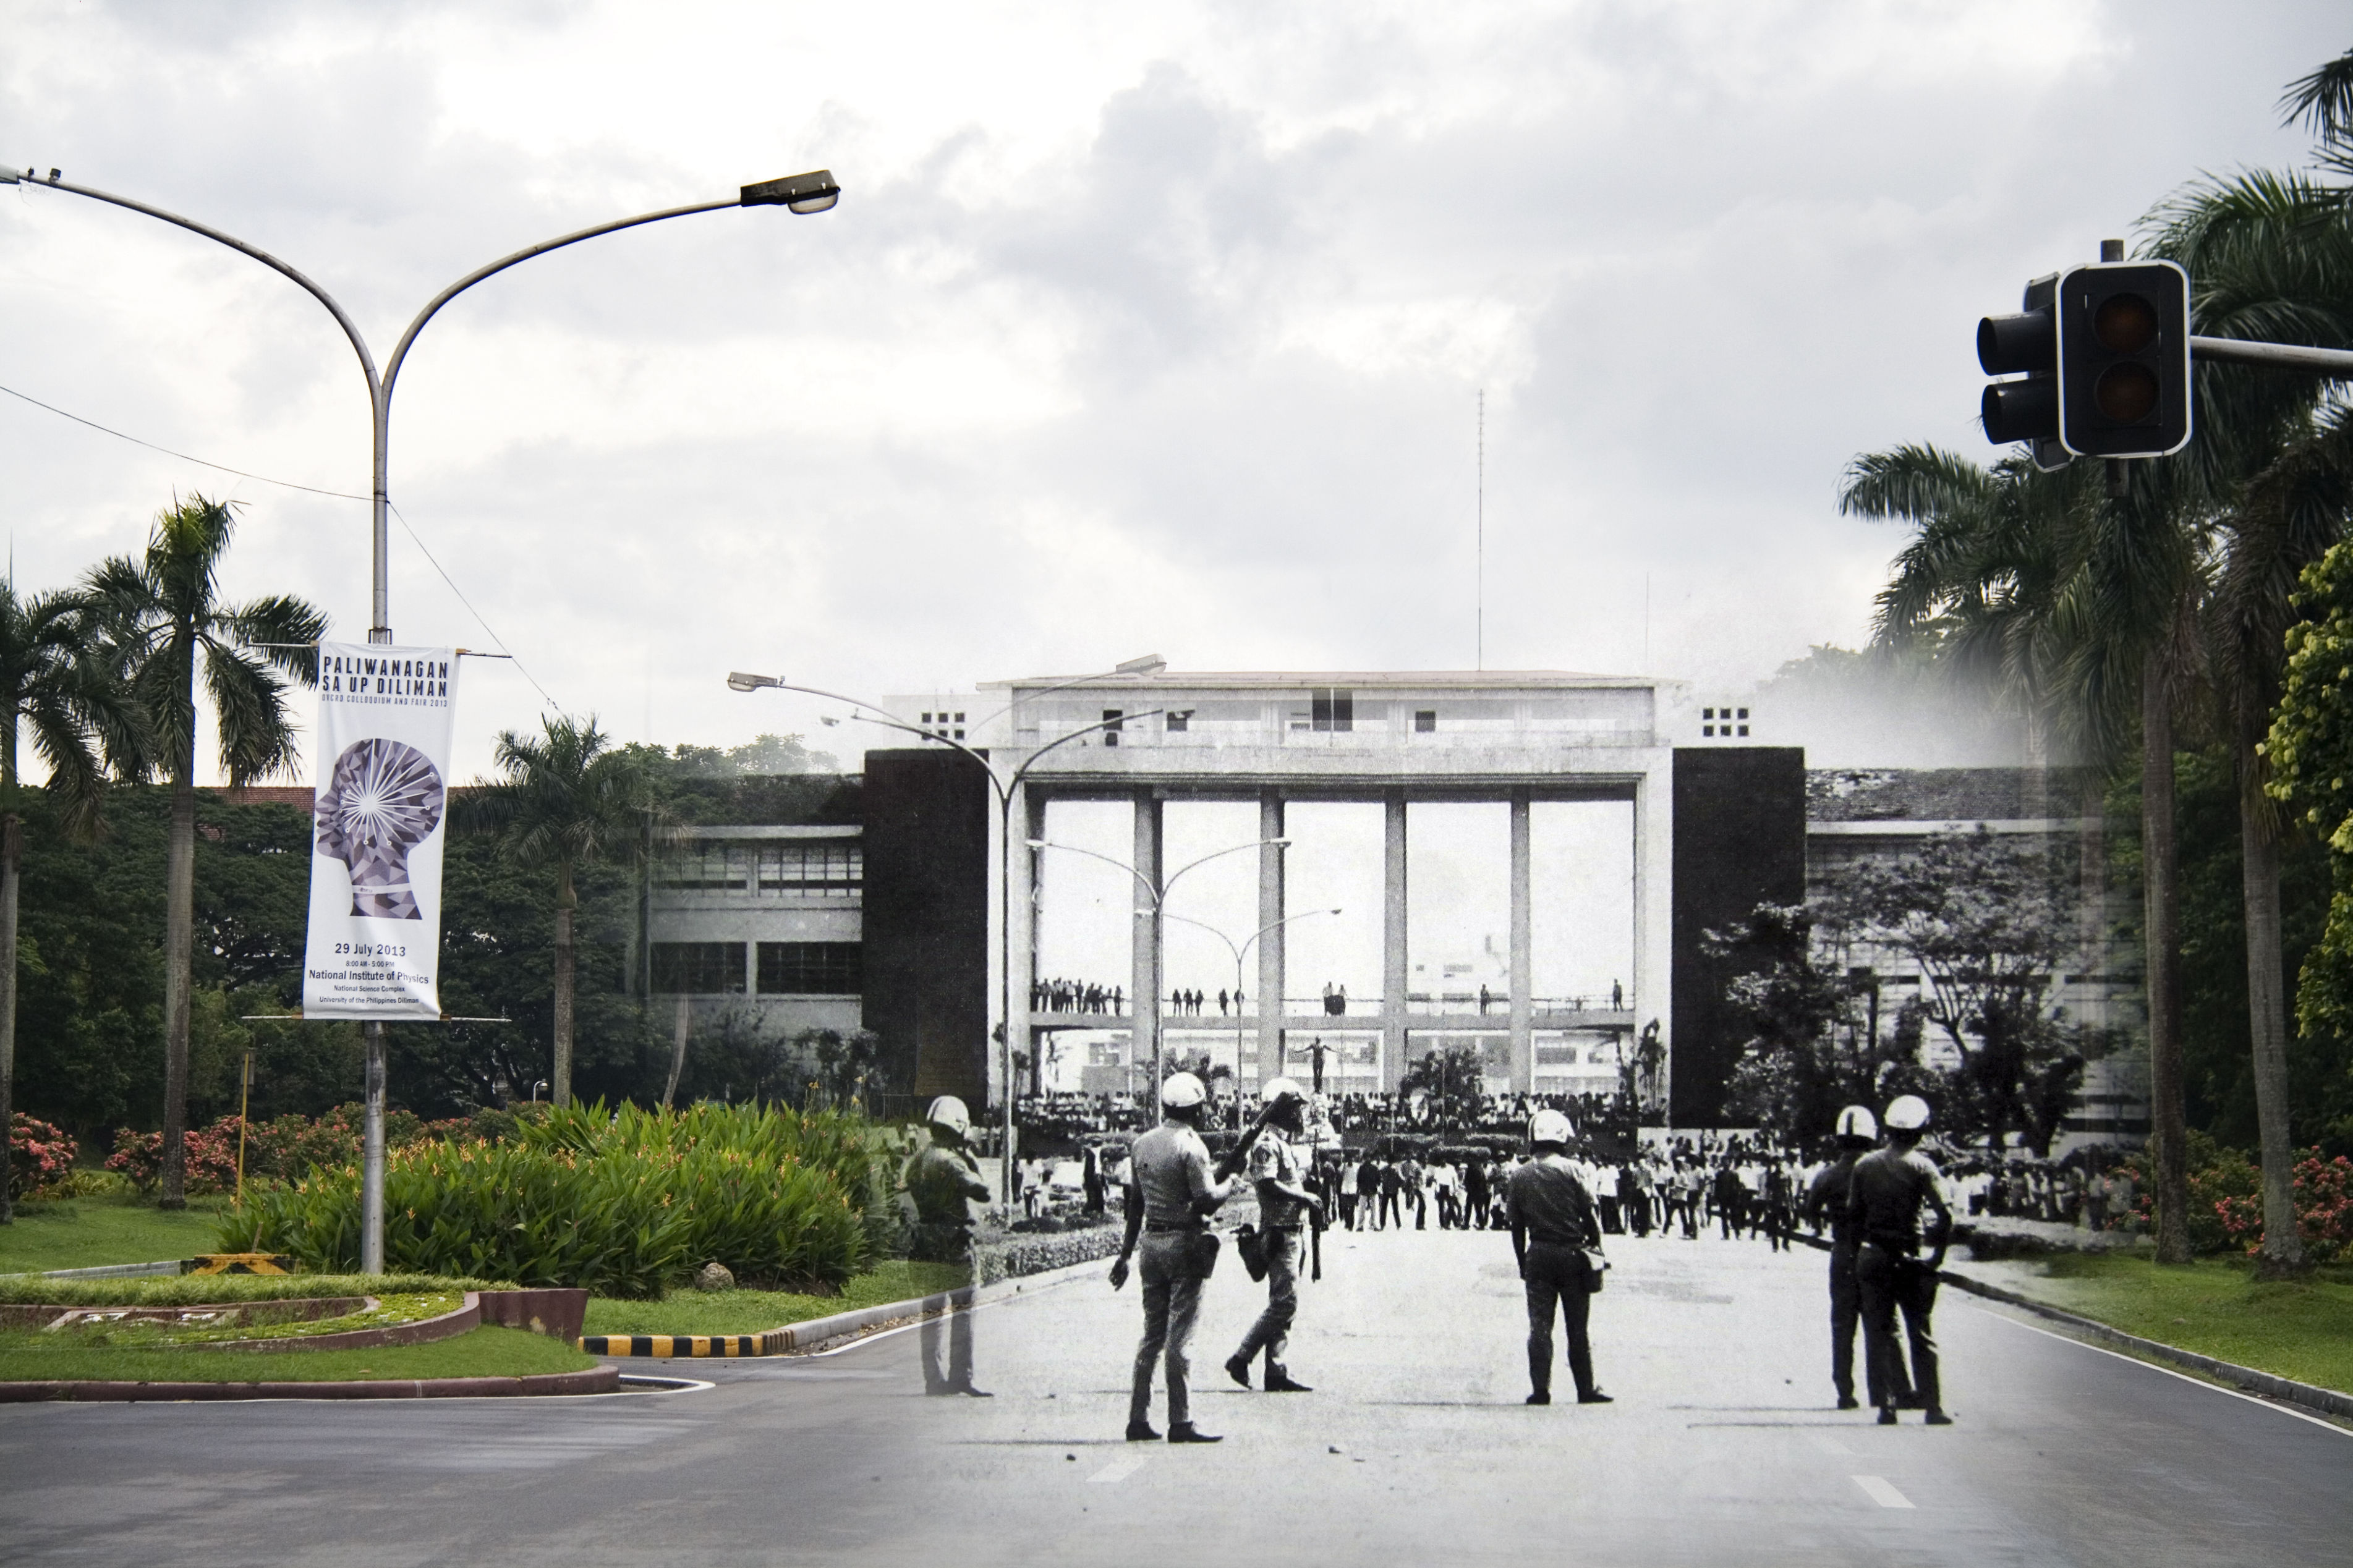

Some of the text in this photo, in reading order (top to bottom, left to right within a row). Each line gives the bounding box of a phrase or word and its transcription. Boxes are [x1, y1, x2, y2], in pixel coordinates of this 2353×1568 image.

[323, 656, 447, 679] PALIWANAGAN
[323, 675, 446, 697] SA UP DILIMAN
[346, 695, 391, 705] COLLOQUIUM
[394, 697, 407, 705] AND
[411, 698, 427, 706] FAIR
[430, 699, 447, 707] 2013
[335, 943, 406, 957] 29 July 2013
[309, 969, 429, 984] National Institute of Physics
[366, 997, 396, 1005] Philippines
